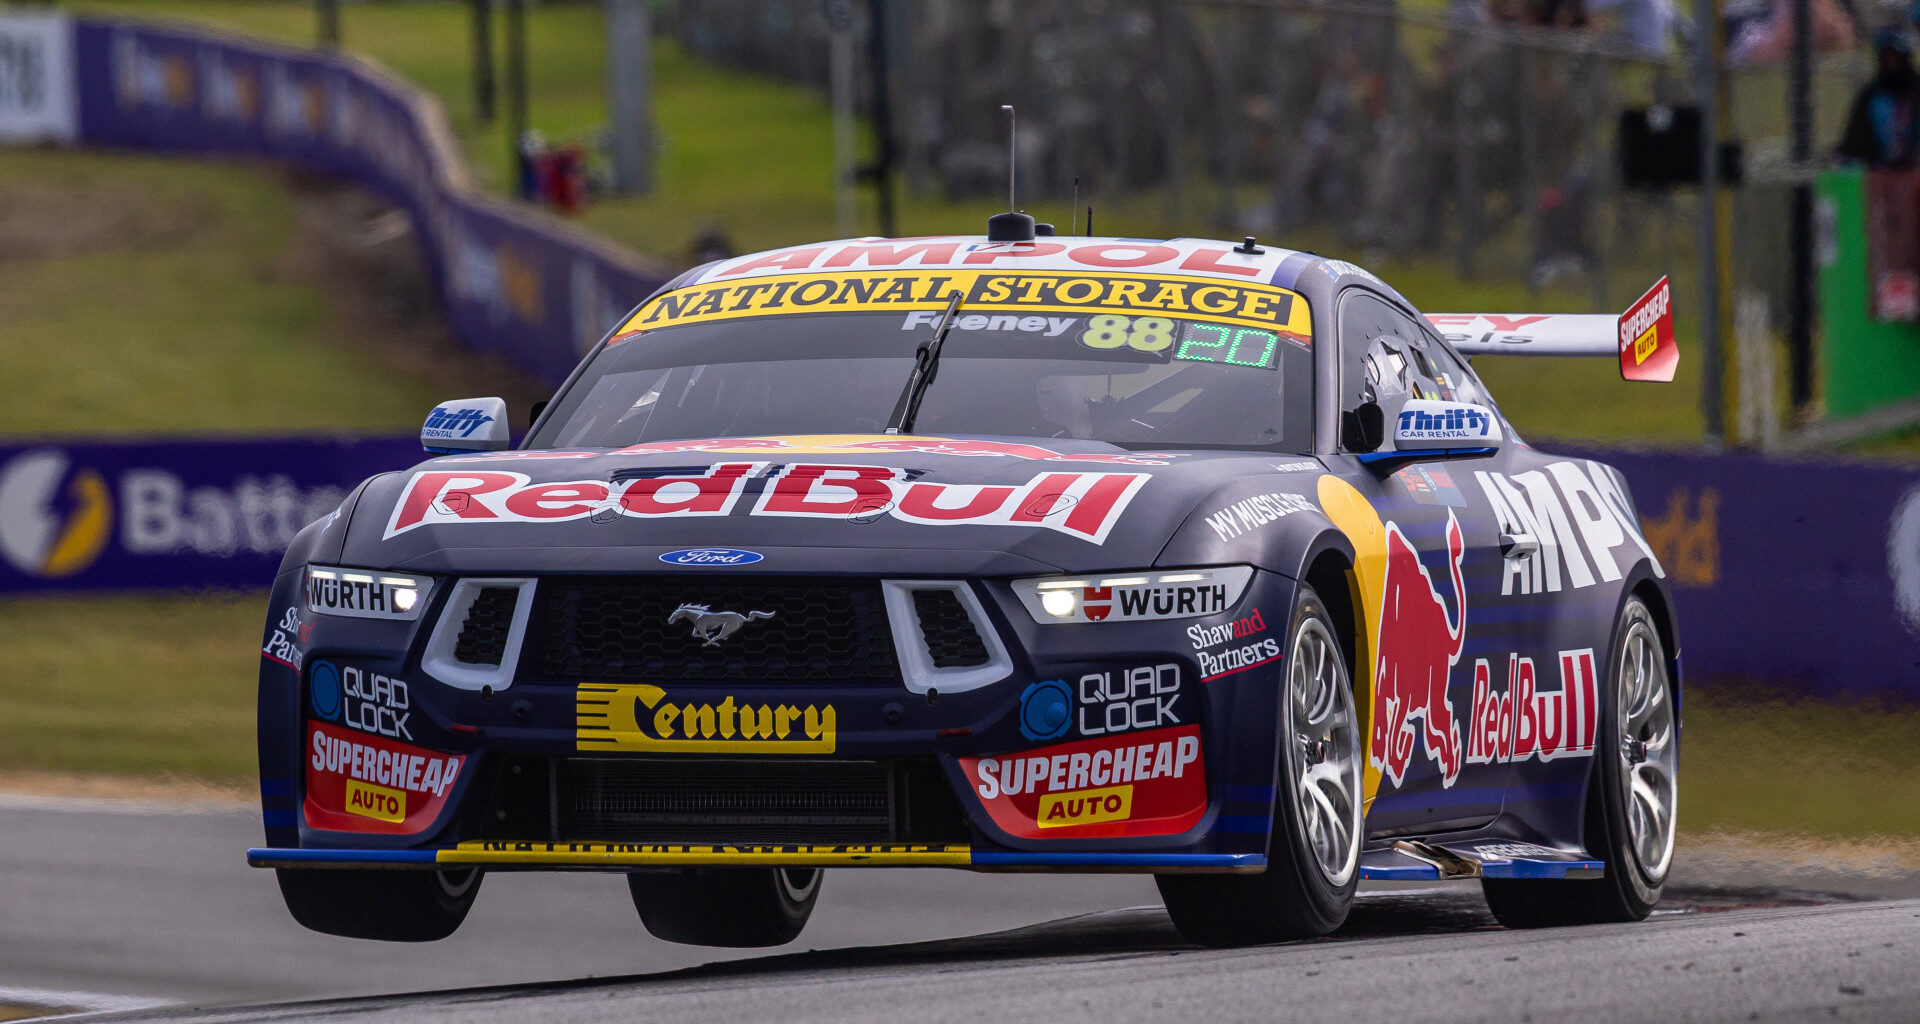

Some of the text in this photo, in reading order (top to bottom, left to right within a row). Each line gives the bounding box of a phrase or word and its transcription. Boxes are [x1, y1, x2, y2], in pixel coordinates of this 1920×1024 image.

[714, 241, 1261, 277] AMPOL
[641, 277, 1281, 324] NATIONAL STORAGE
[1621, 284, 1669, 352] SUPERCHEAP
[901, 311, 1077, 337] Feeney
[1081, 313, 1175, 352] 88
[1176, 323, 1279, 367] 20
[1637, 333, 1655, 358] AUTO
[425, 407, 495, 438] Thrifty
[426, 429, 453, 438] RENTAL
[1398, 409, 1490, 436] Thrifty
[1401, 430, 1470, 438] CAR RENTAL
[386, 462, 765, 539] Red
[754, 463, 1149, 543] Bull
[1205, 508, 1243, 542] MY
[677, 551, 744, 565] Ford
[311, 577, 386, 611] WÜRTH
[1119, 584, 1226, 616] WÜRTH
[1198, 638, 1280, 679] Partners
[343, 666, 410, 710] QUAD
[1079, 662, 1181, 703] QUAD
[344, 697, 414, 741] LOCK
[579, 683, 836, 752] Century
[1079, 694, 1181, 736] LOCK
[1467, 649, 1598, 763] Red Bull
[312, 730, 459, 797] SUPERCHEAP
[977, 735, 1199, 800] SUPERCHEAP
[351, 788, 399, 815] AUTO
[1046, 794, 1123, 820] AUTO
